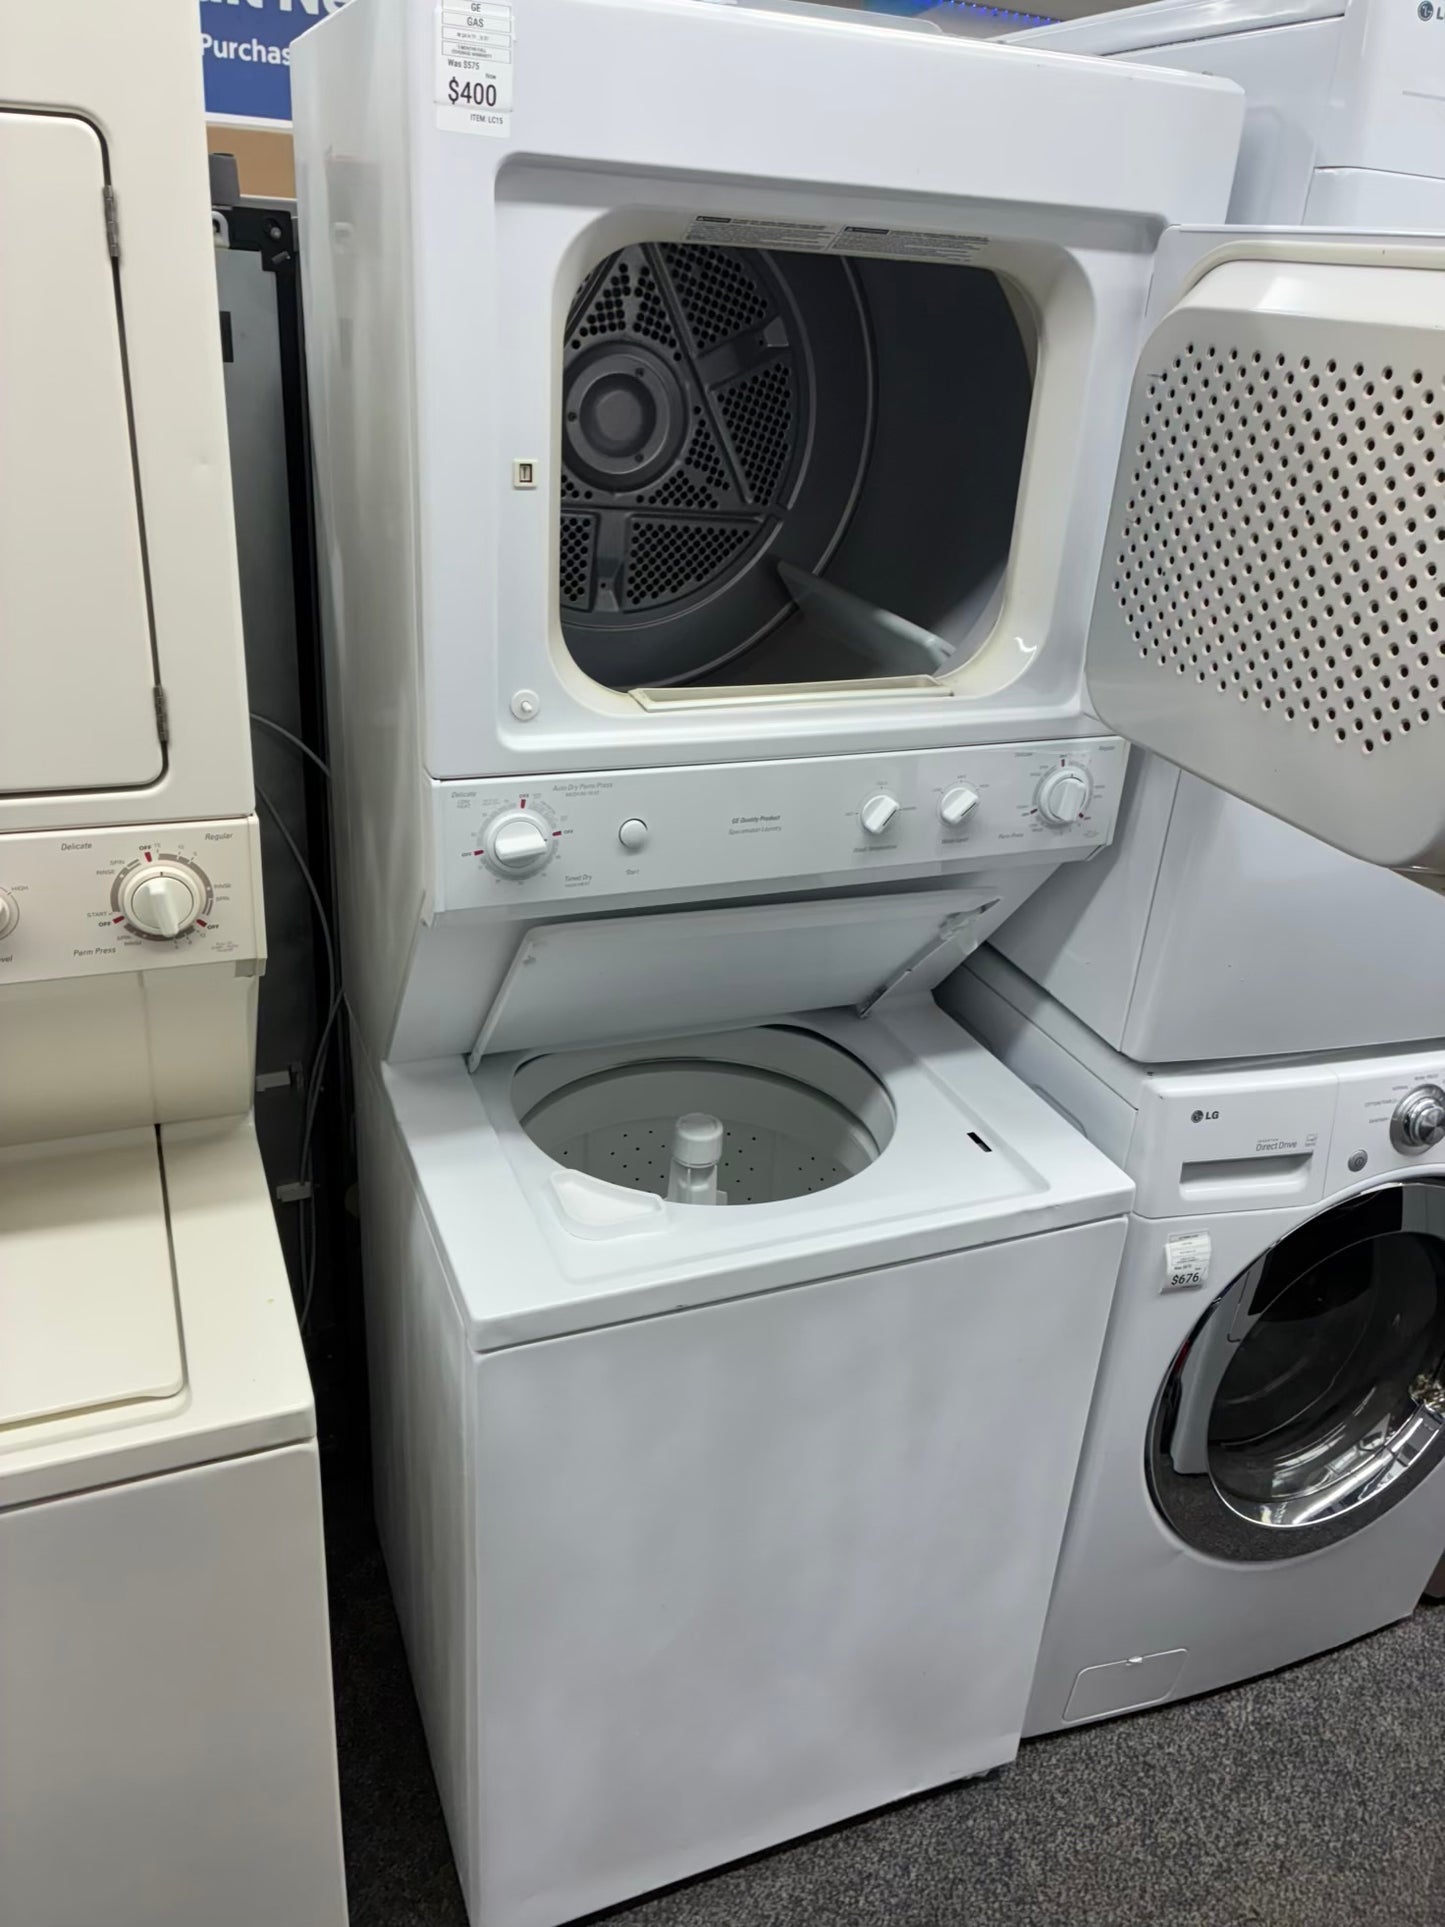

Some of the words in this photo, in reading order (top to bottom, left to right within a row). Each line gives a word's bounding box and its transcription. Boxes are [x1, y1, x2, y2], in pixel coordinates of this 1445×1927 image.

[471, 3, 481, 12] GE
[1436, 7, 1445, 20] L
[467, 16, 484, 28] GAS
[448, 59, 462, 68] Was
[448, 76, 497, 107] $400
[567, 783, 578, 791] Dry
[204, 831, 233, 841] Regular
[61, 843, 92, 851] Delicate
[582, 873, 592, 882] Dry
[1205, 1111, 1219, 1120] LG
[1256, 1142, 1278, 1151] Direct
[1279, 1141, 1297, 1149] Drive
[1171, 1272, 1200, 1286] $676
